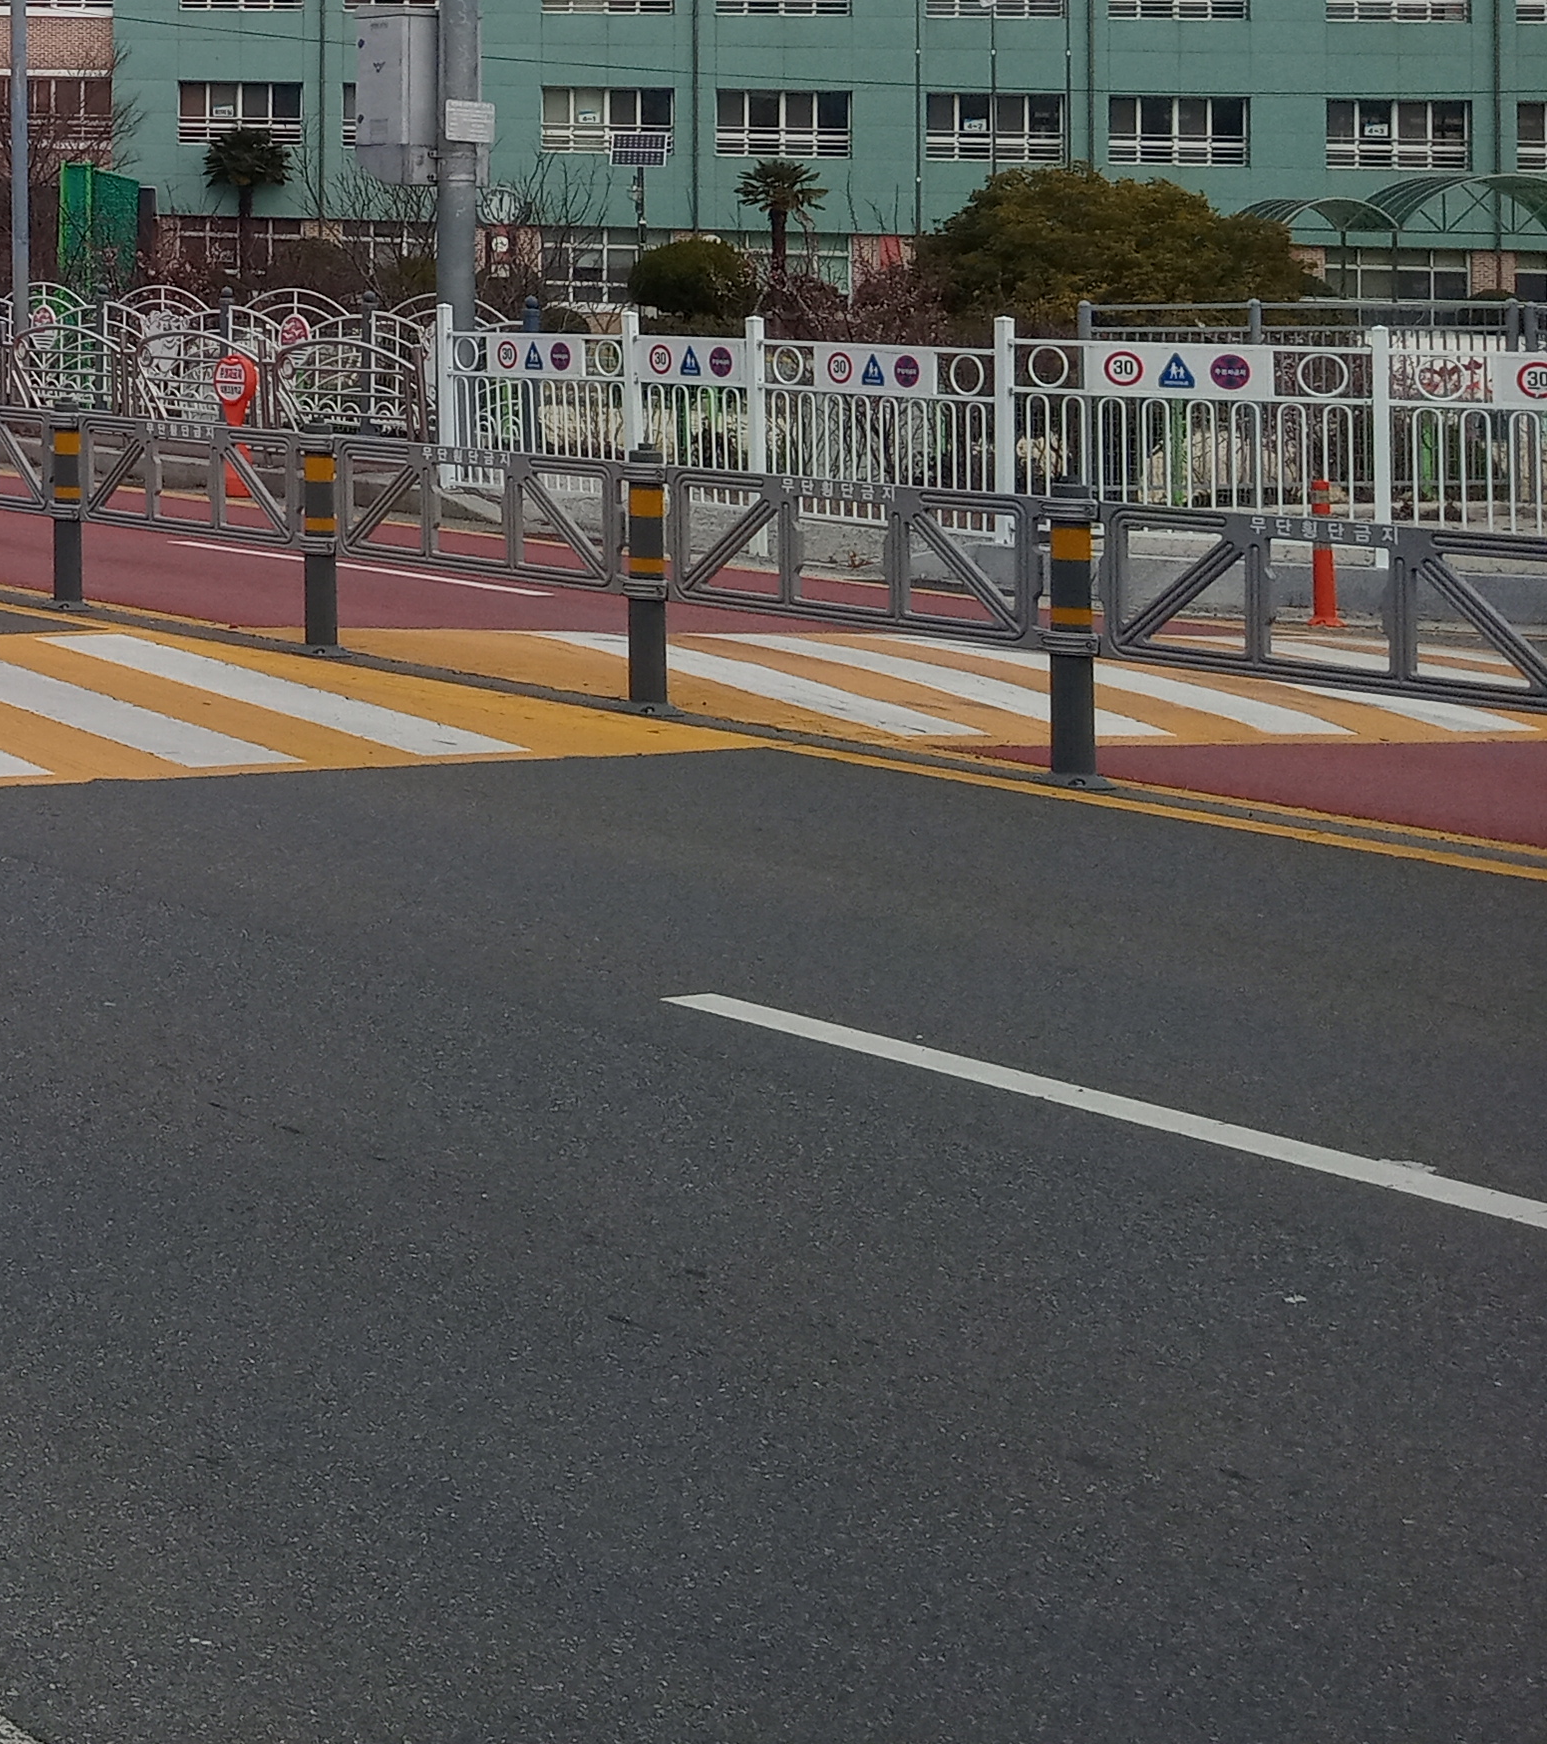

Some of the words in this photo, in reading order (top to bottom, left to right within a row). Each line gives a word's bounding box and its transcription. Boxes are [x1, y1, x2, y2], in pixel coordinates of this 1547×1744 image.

[501, 347, 513, 361] 30
[654, 351, 667, 366] 30
[833, 359, 847, 374] 30
[1112, 359, 1134, 376] 30
[145, 422, 215, 440] 무단횡단금지
[421, 446, 511, 468] 무단횡단금지
[781, 477, 895, 502] 무단횡단금지
[1249, 515, 1400, 546] 무단횡단금지
